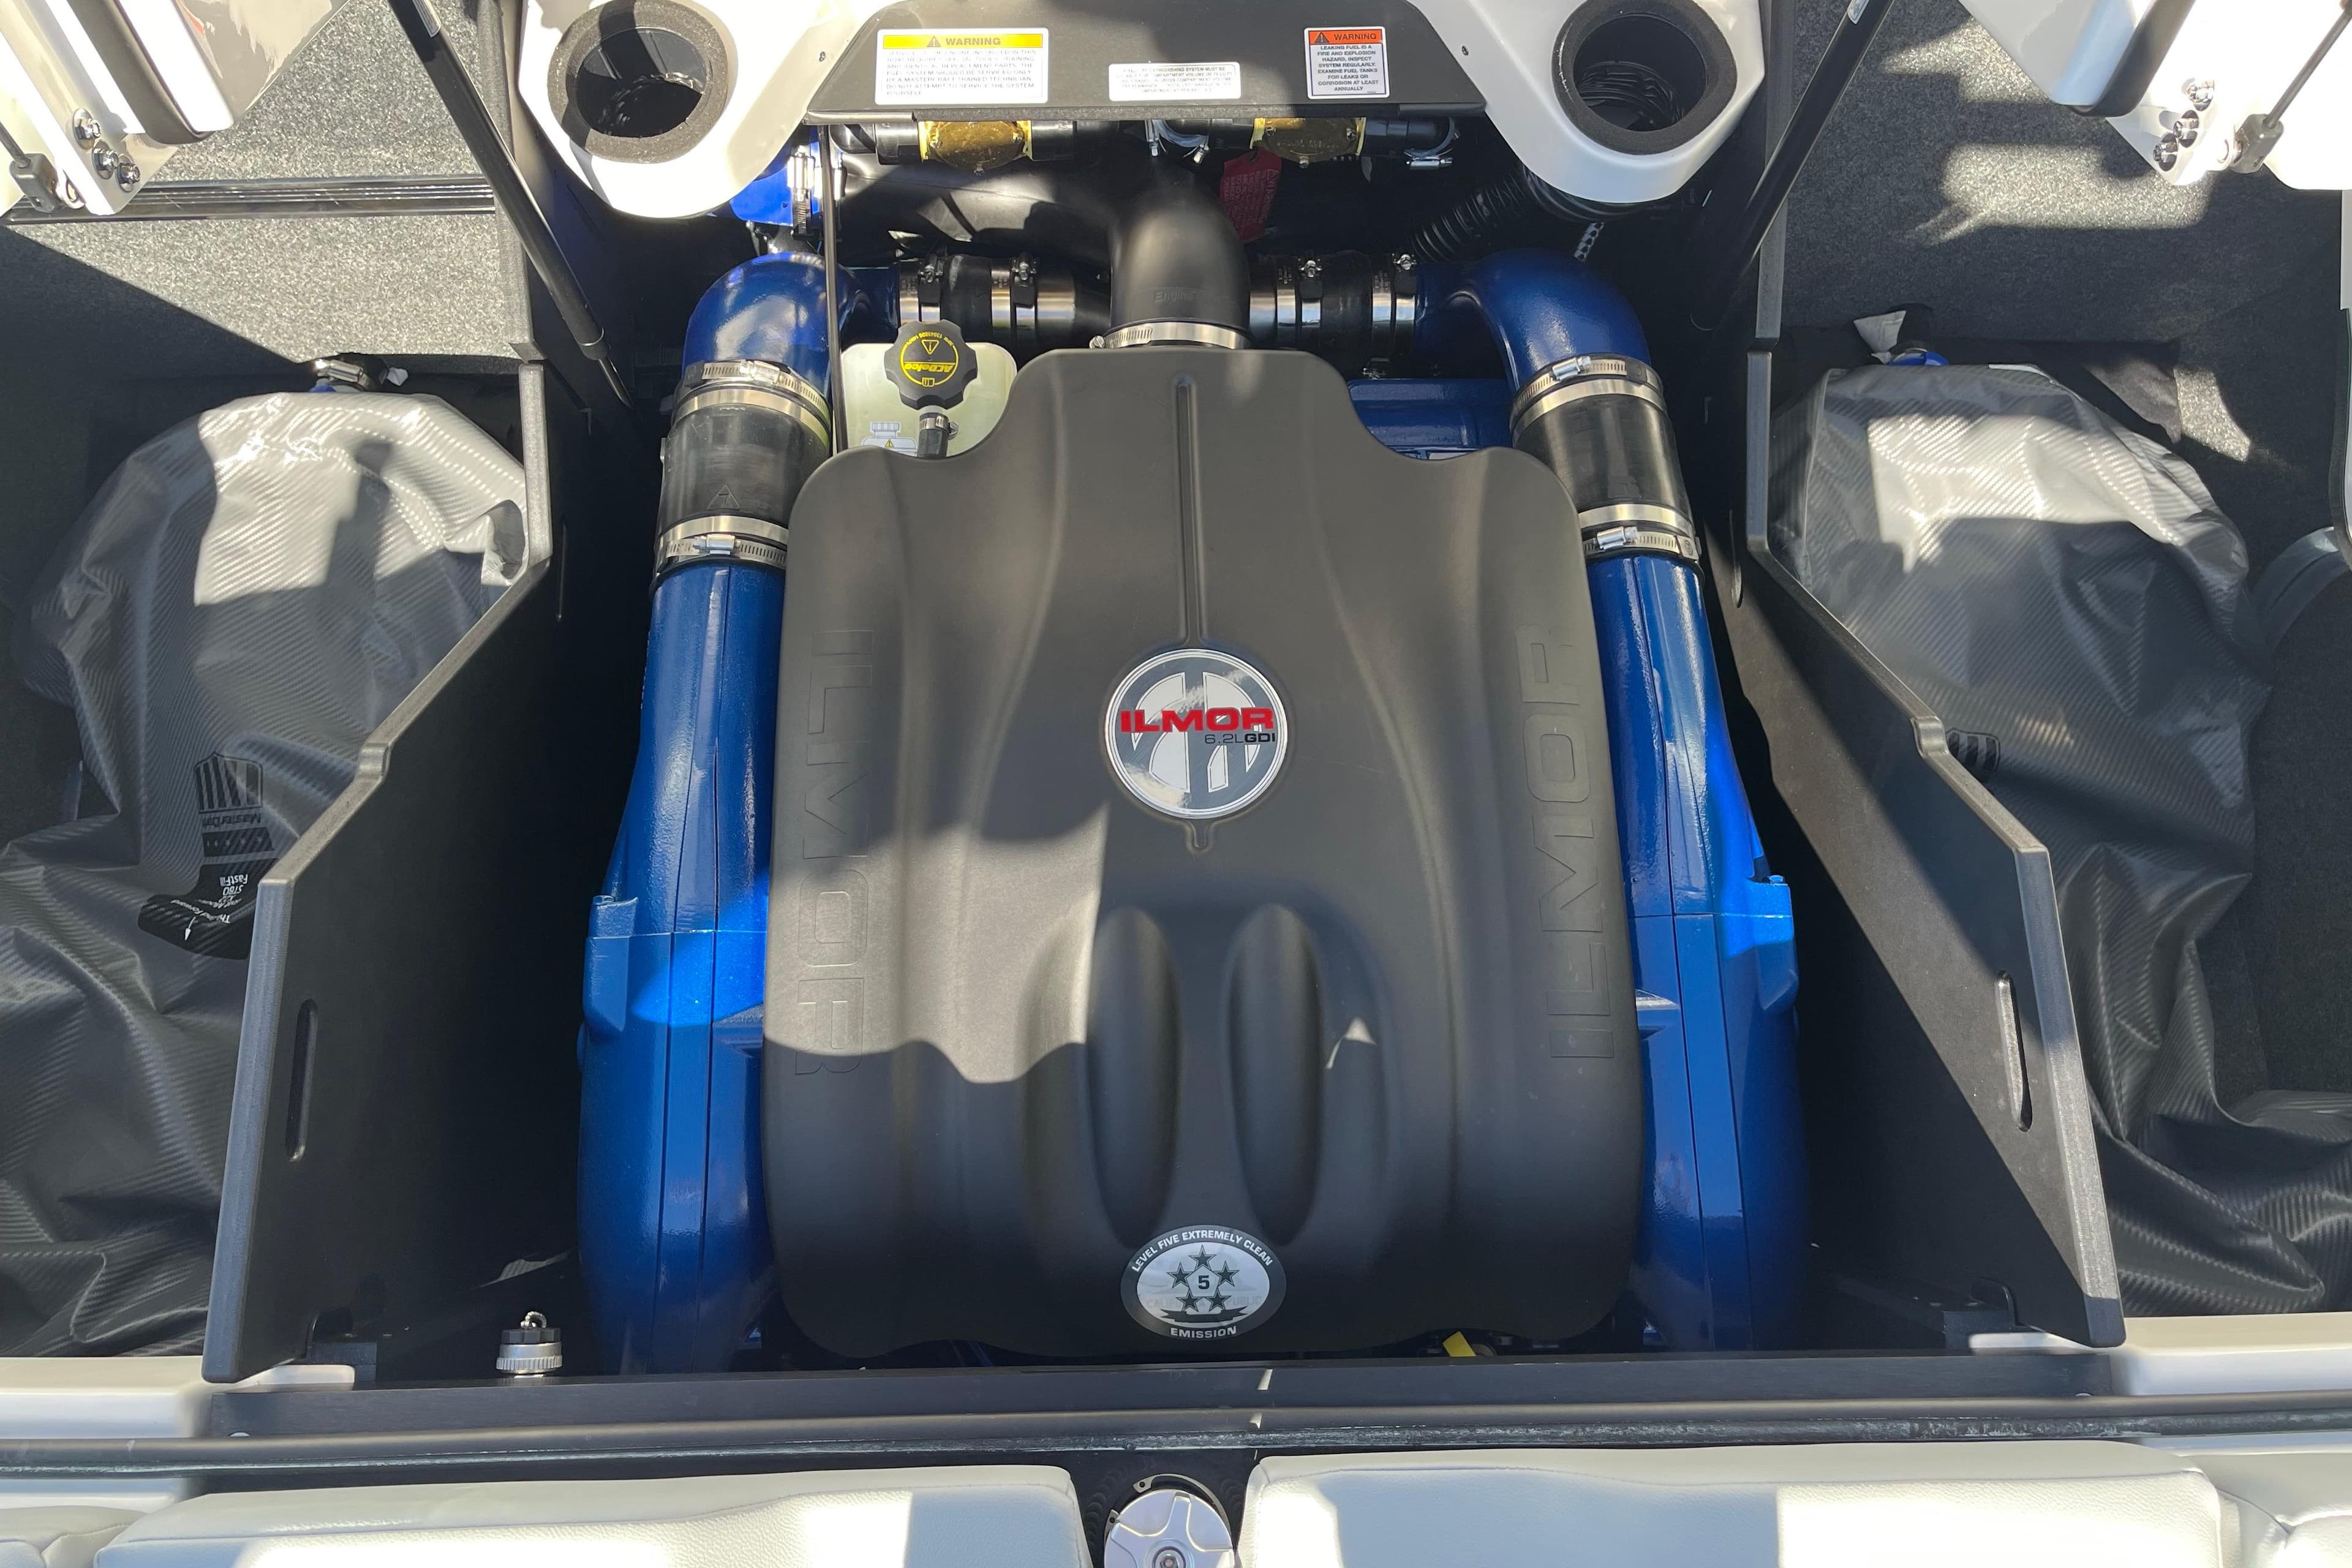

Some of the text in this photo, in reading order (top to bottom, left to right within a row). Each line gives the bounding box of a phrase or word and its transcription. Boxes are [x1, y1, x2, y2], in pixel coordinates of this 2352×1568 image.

[903, 363, 956, 373] ACDelco
[1119, 707, 1275, 733] ILMOR
[795, 630, 875, 1076] ILMOR
[1515, 624, 1615, 1058] ILMOR
[1132, 1229, 1274, 1272] LEVEL FIVE EXTREMELY CLEAN
[1198, 1275, 1210, 1290] 5
[1170, 1325, 1237, 1338] EMISSION
